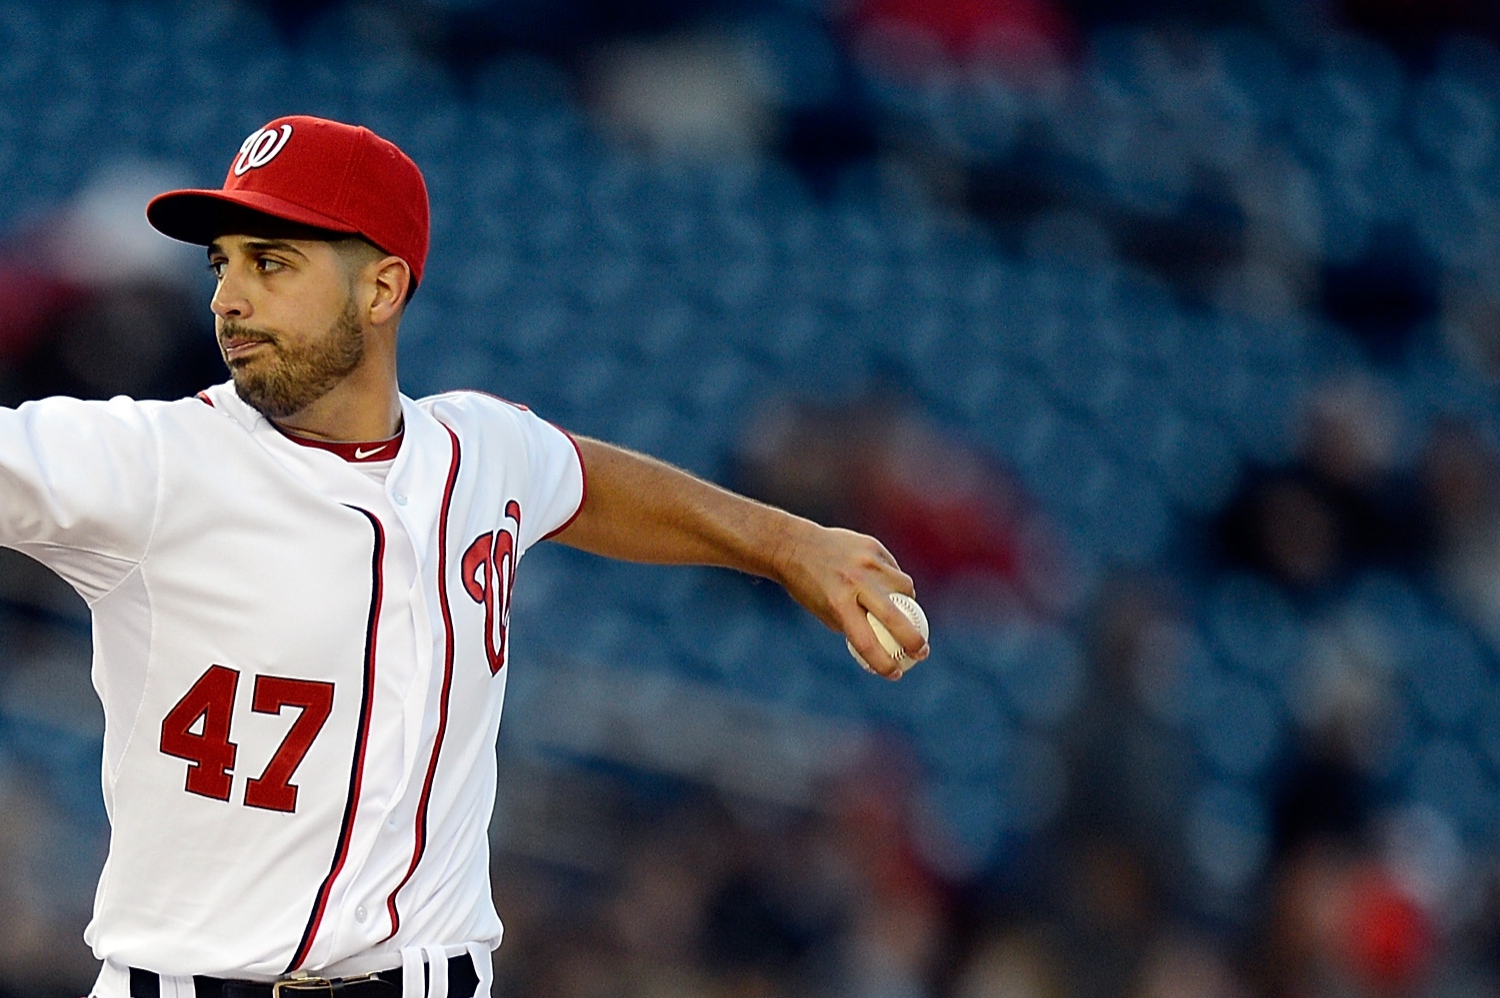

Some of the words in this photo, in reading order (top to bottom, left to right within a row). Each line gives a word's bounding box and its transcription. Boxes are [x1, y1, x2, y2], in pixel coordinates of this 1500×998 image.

[234, 124, 293, 176] W
[461, 499, 521, 677] W
[159, 664, 335, 813] 47
